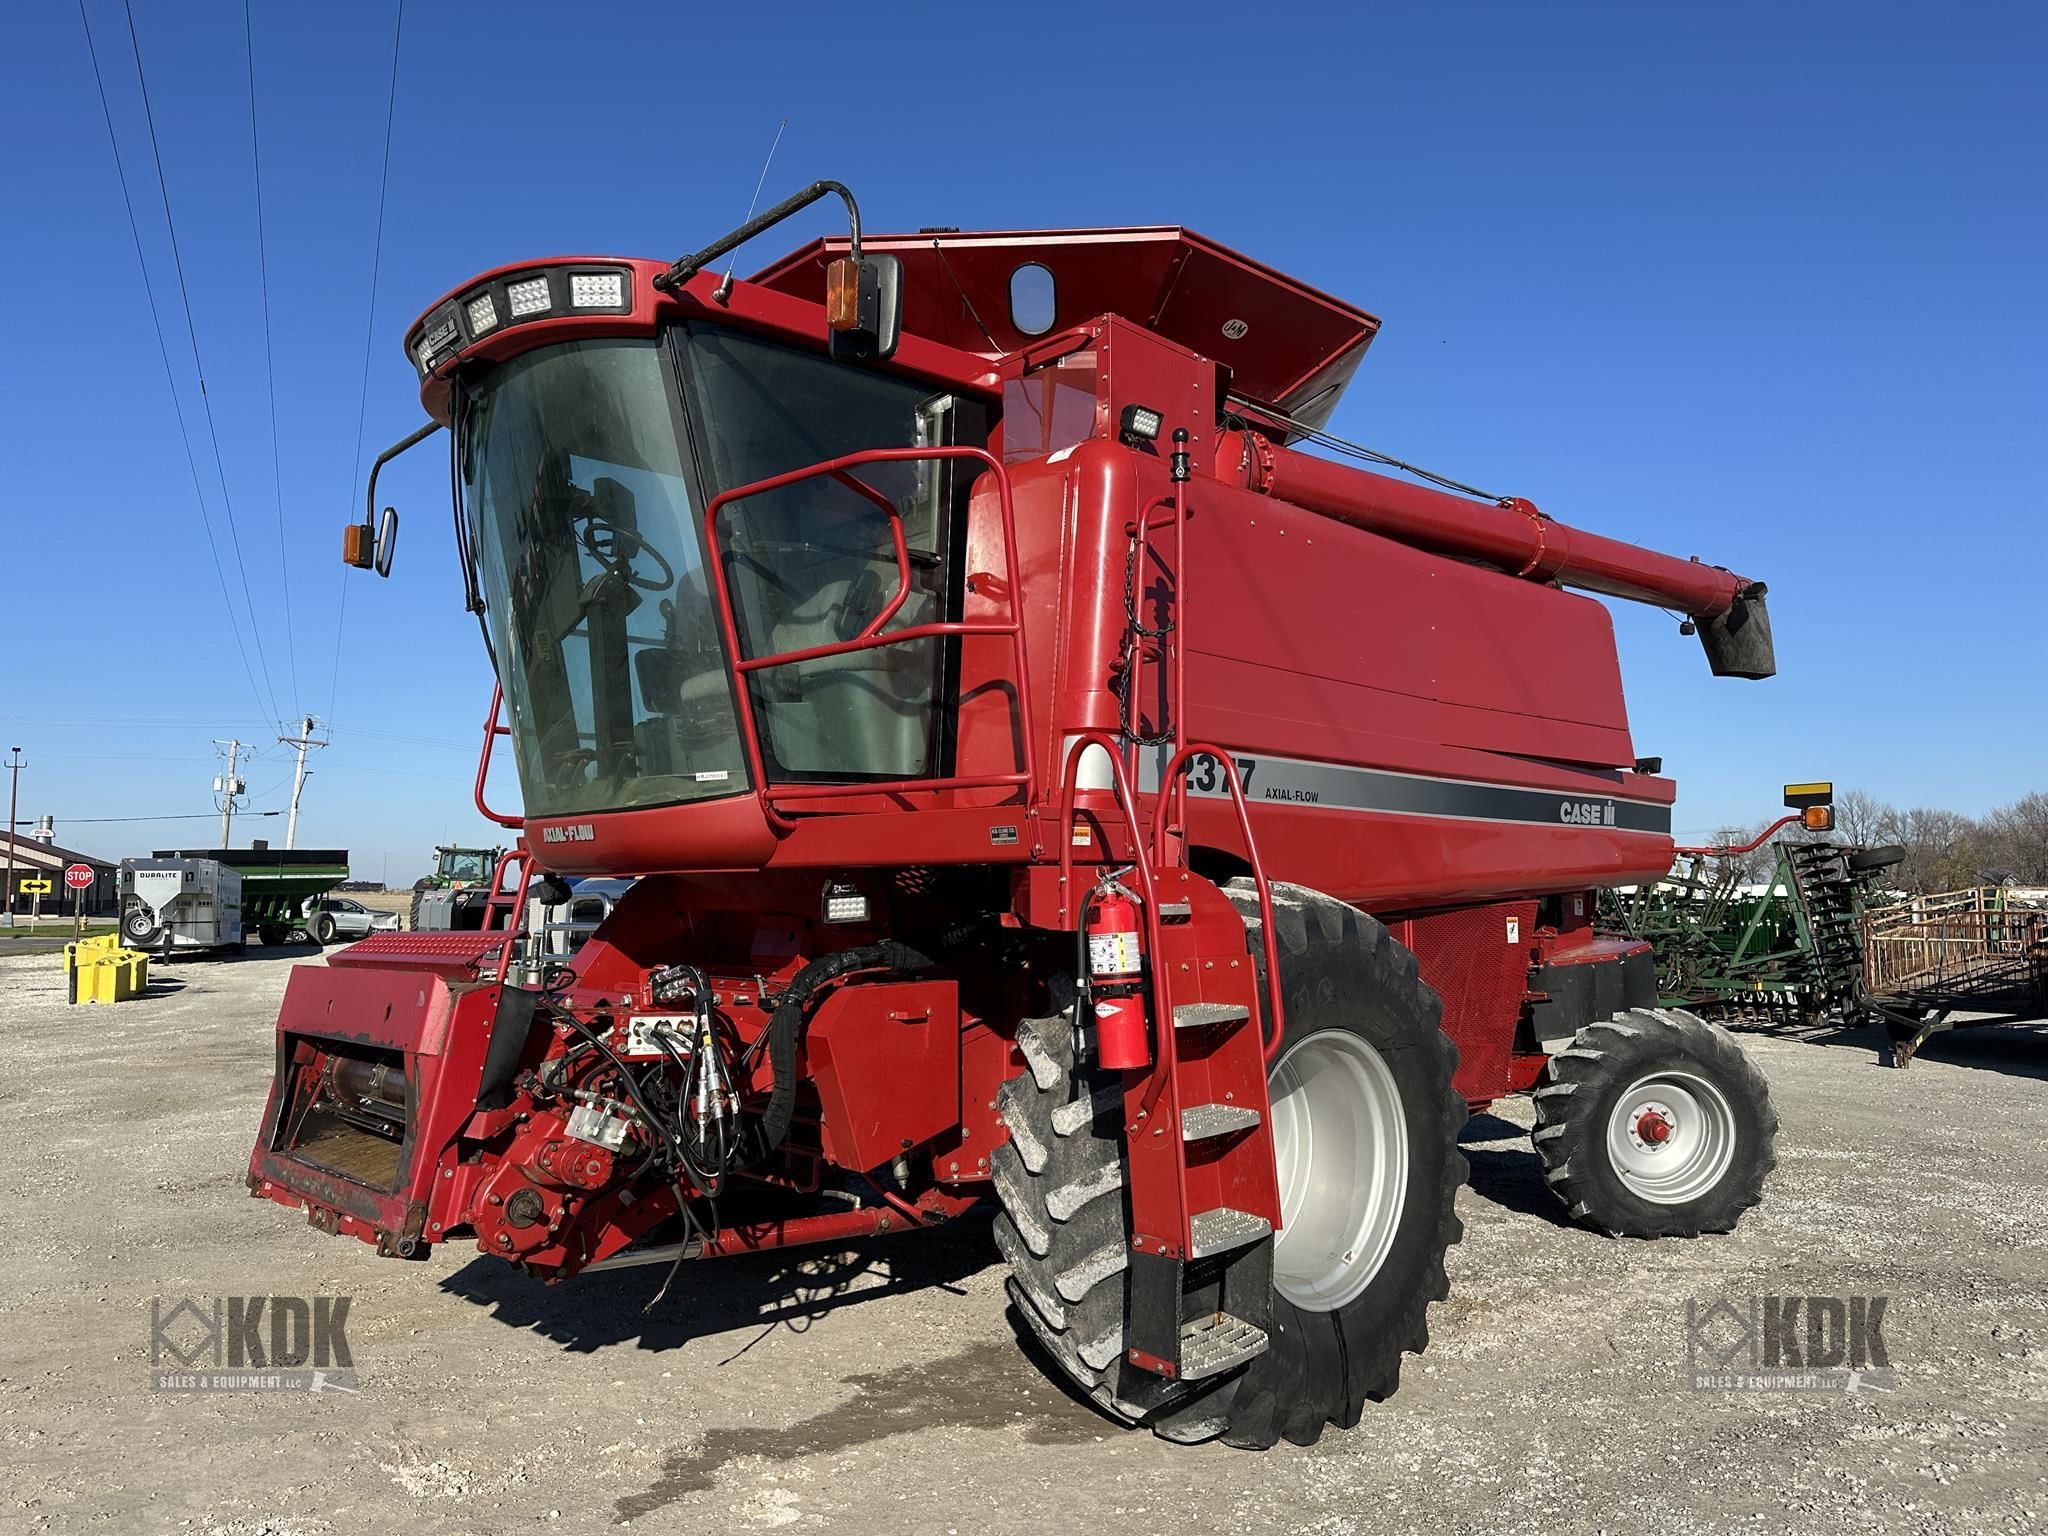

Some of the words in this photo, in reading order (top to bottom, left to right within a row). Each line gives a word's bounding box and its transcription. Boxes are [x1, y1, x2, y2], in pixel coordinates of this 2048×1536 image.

[1265, 787, 1319, 803] AXIAL-FLOW
[1560, 801, 1601, 825] CASE
[543, 824, 594, 843] AXIAL-FLOW
[67, 871, 92, 881] STOP
